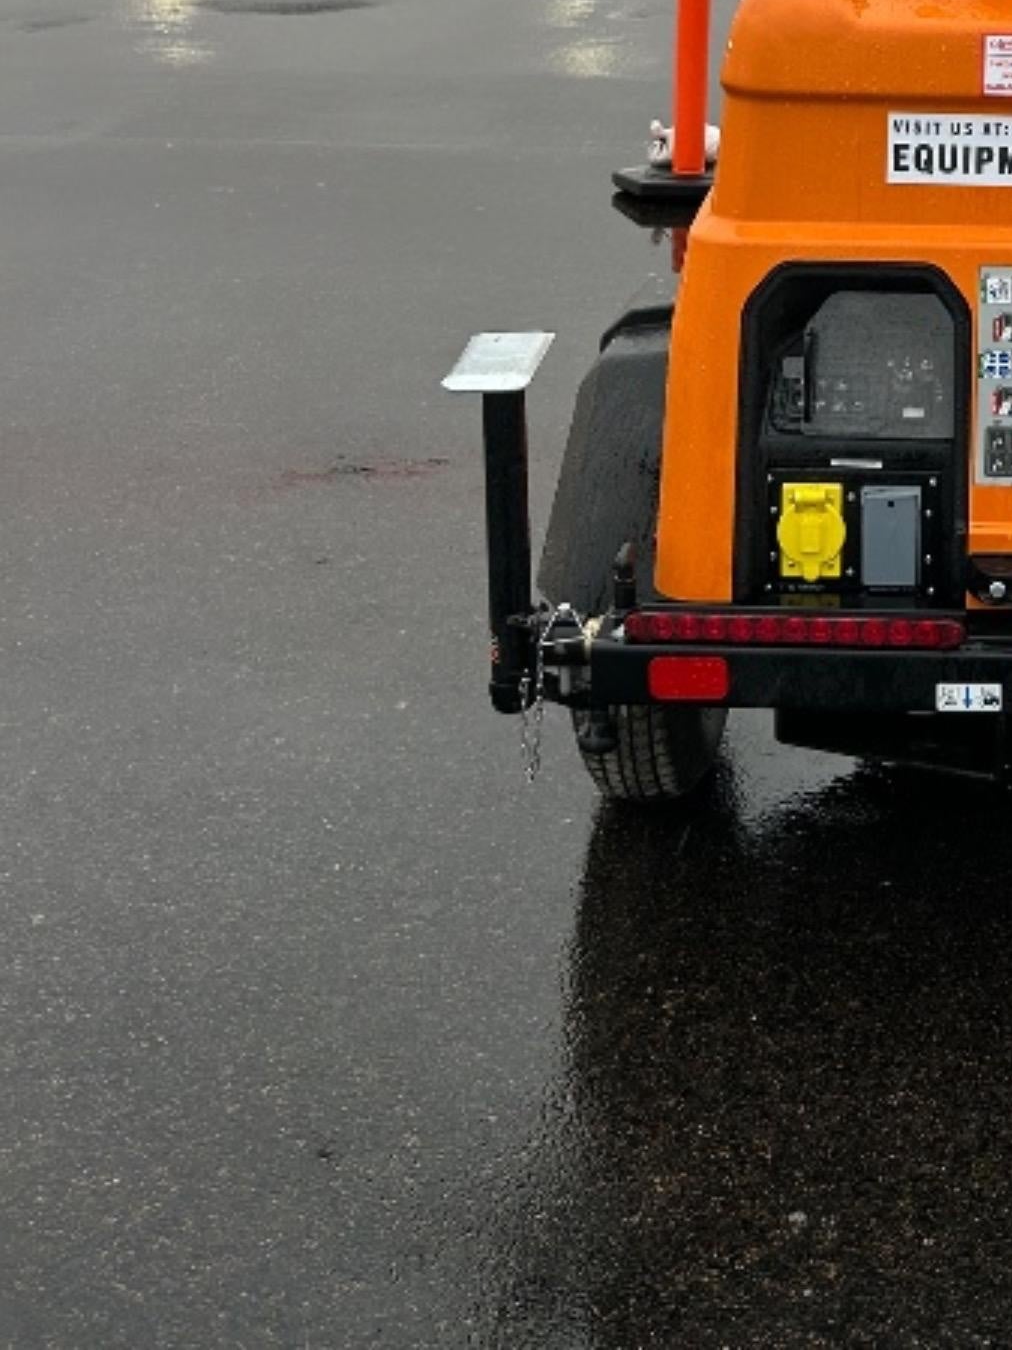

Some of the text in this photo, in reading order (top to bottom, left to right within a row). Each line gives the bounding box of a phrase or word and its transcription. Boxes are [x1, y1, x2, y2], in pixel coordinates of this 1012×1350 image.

[893, 119, 1010, 136] VISIT US AT:
